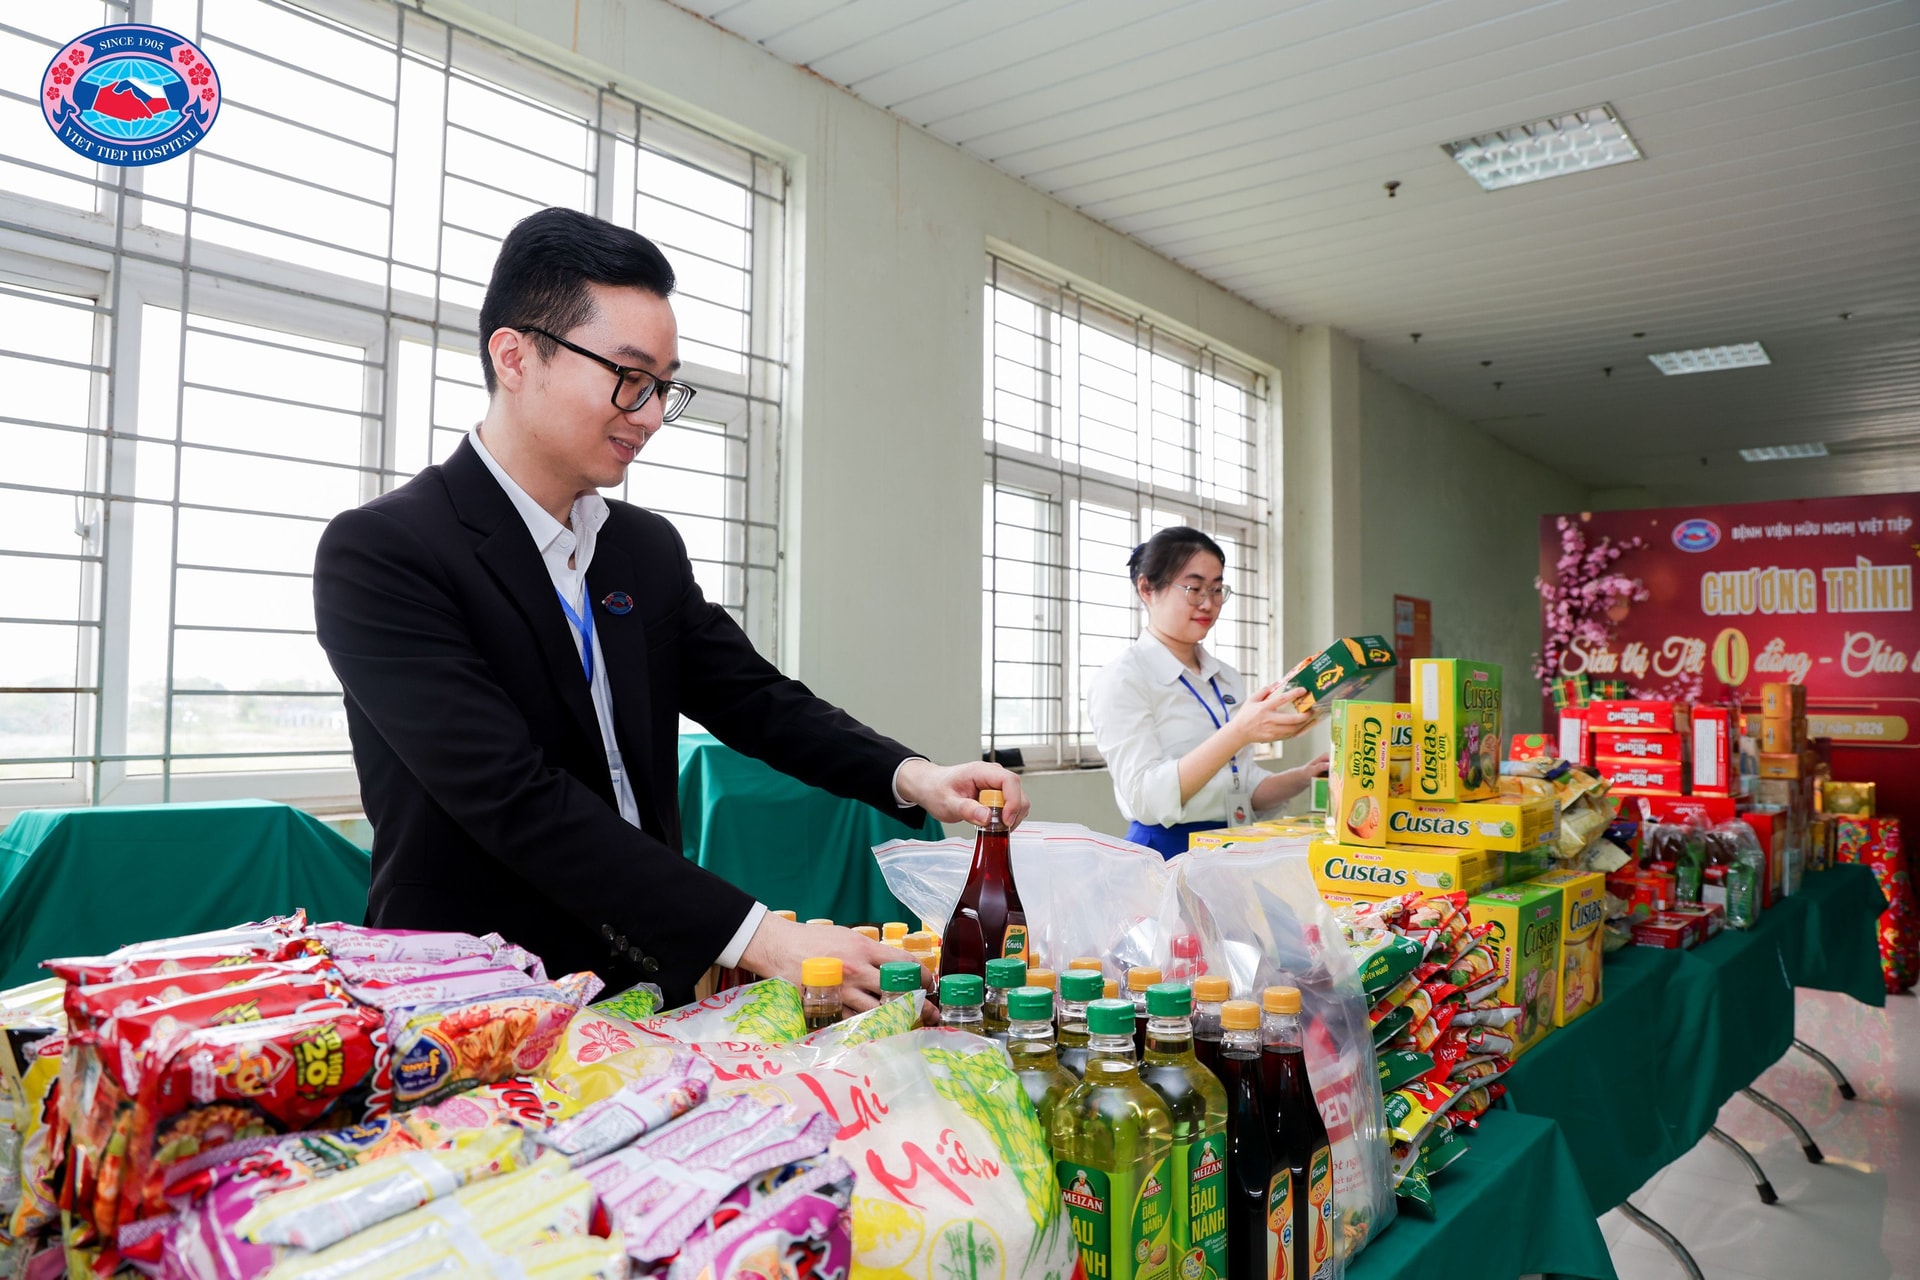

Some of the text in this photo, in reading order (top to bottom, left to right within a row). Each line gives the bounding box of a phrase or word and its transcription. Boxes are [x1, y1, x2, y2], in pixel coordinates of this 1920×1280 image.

[1701, 555, 1913, 616] CHƯƠNG TRÌNH
[1711, 627, 1749, 687] 0
[1362, 716, 1382, 790] Custas
[1420, 722, 1439, 795] Custas
[1389, 811, 1471, 836] Custas
[1324, 858, 1407, 886] Custas
[1570, 900, 1602, 935] Custas
[1524, 919, 1559, 959] Custas
[1193, 1160, 1223, 1181] MEIZAN
[1312, 1165, 1328, 1180] Knorr
[1061, 1190, 1103, 1212] MEIZAN
[1143, 1185, 1162, 1198] MEIZAN
[1270, 1187, 1288, 1204] Knorr
[1192, 1207, 1226, 1244] NÀNH
[1083, 1247, 1106, 1278] NH
